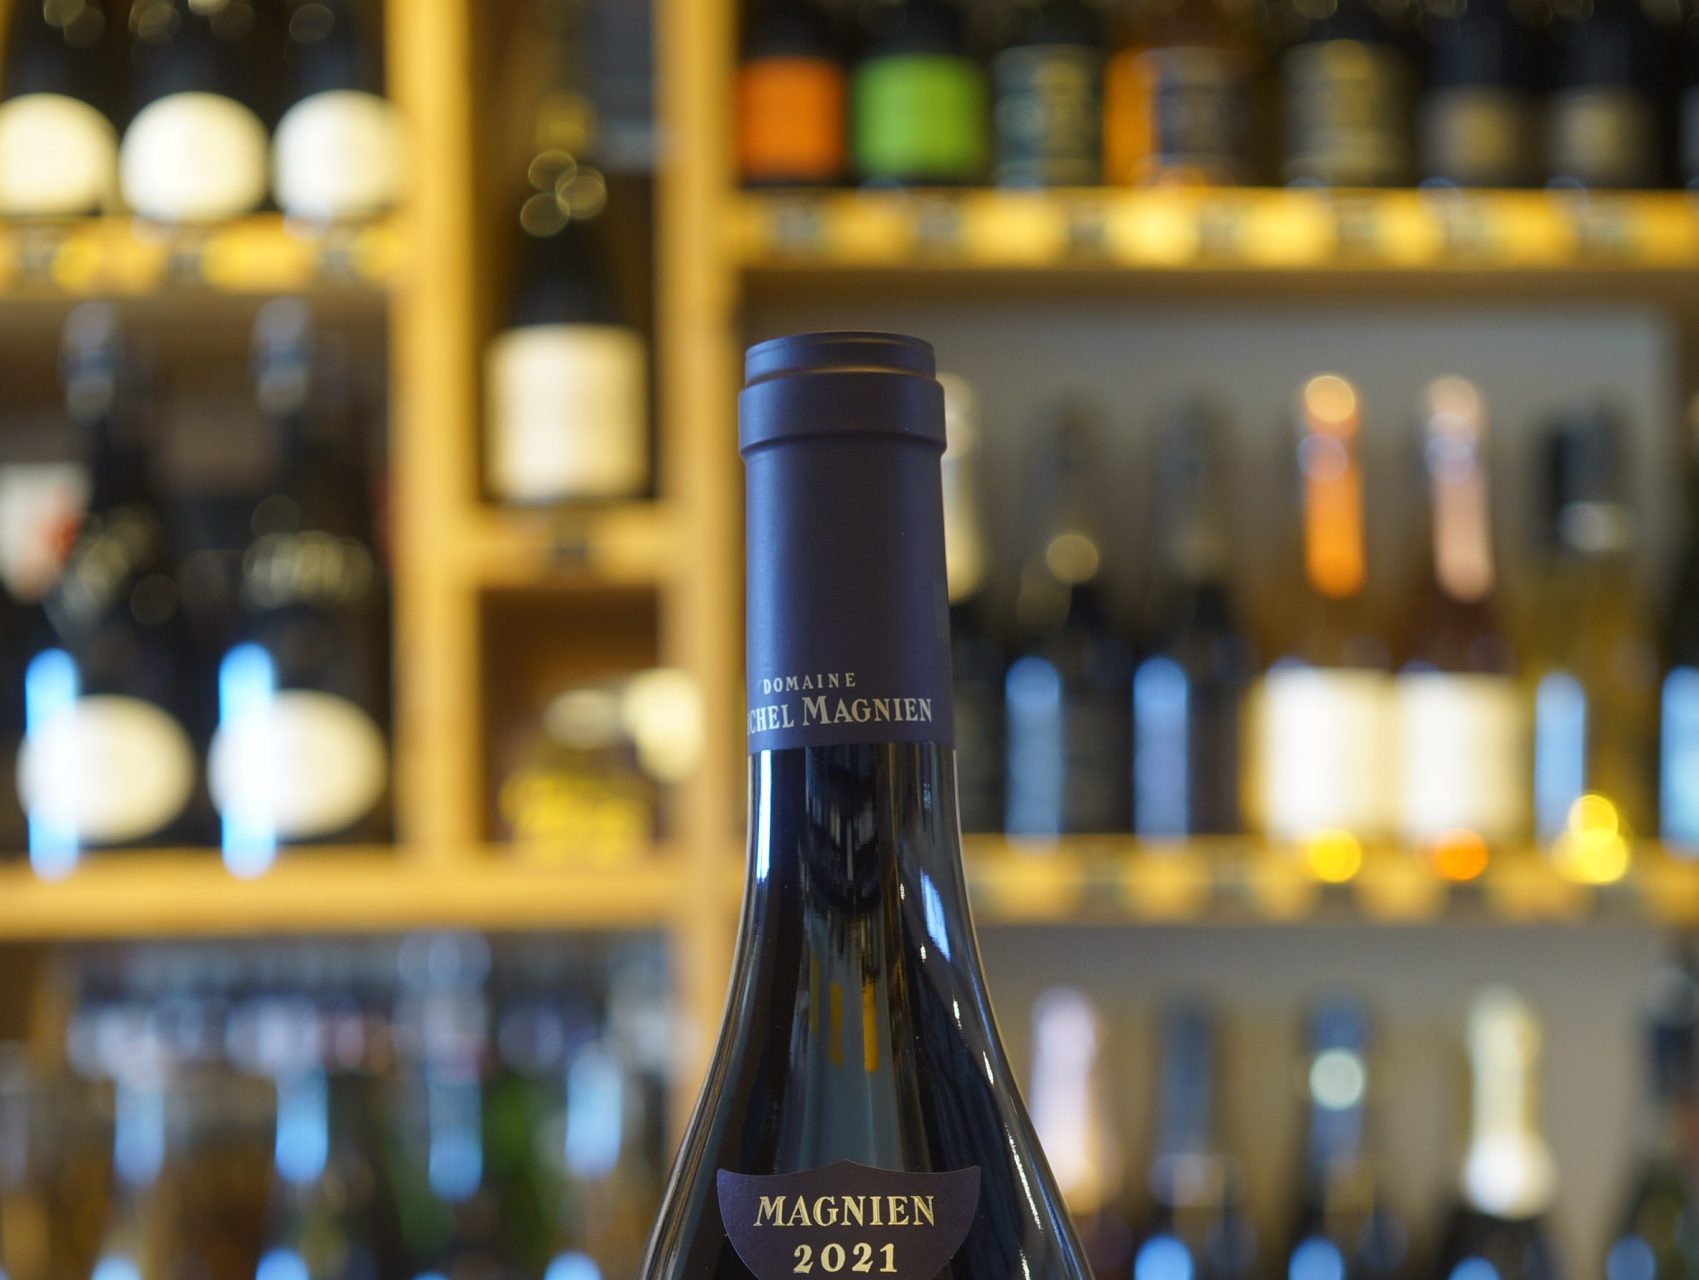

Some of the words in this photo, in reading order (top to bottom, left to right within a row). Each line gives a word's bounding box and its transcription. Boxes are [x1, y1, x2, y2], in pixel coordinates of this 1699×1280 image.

[763, 672, 856, 695] DOMAINE
[802, 695, 933, 726] MAGNIEN
[753, 1195, 935, 1227] MAGNIEN
[793, 1242, 898, 1274] 2021
